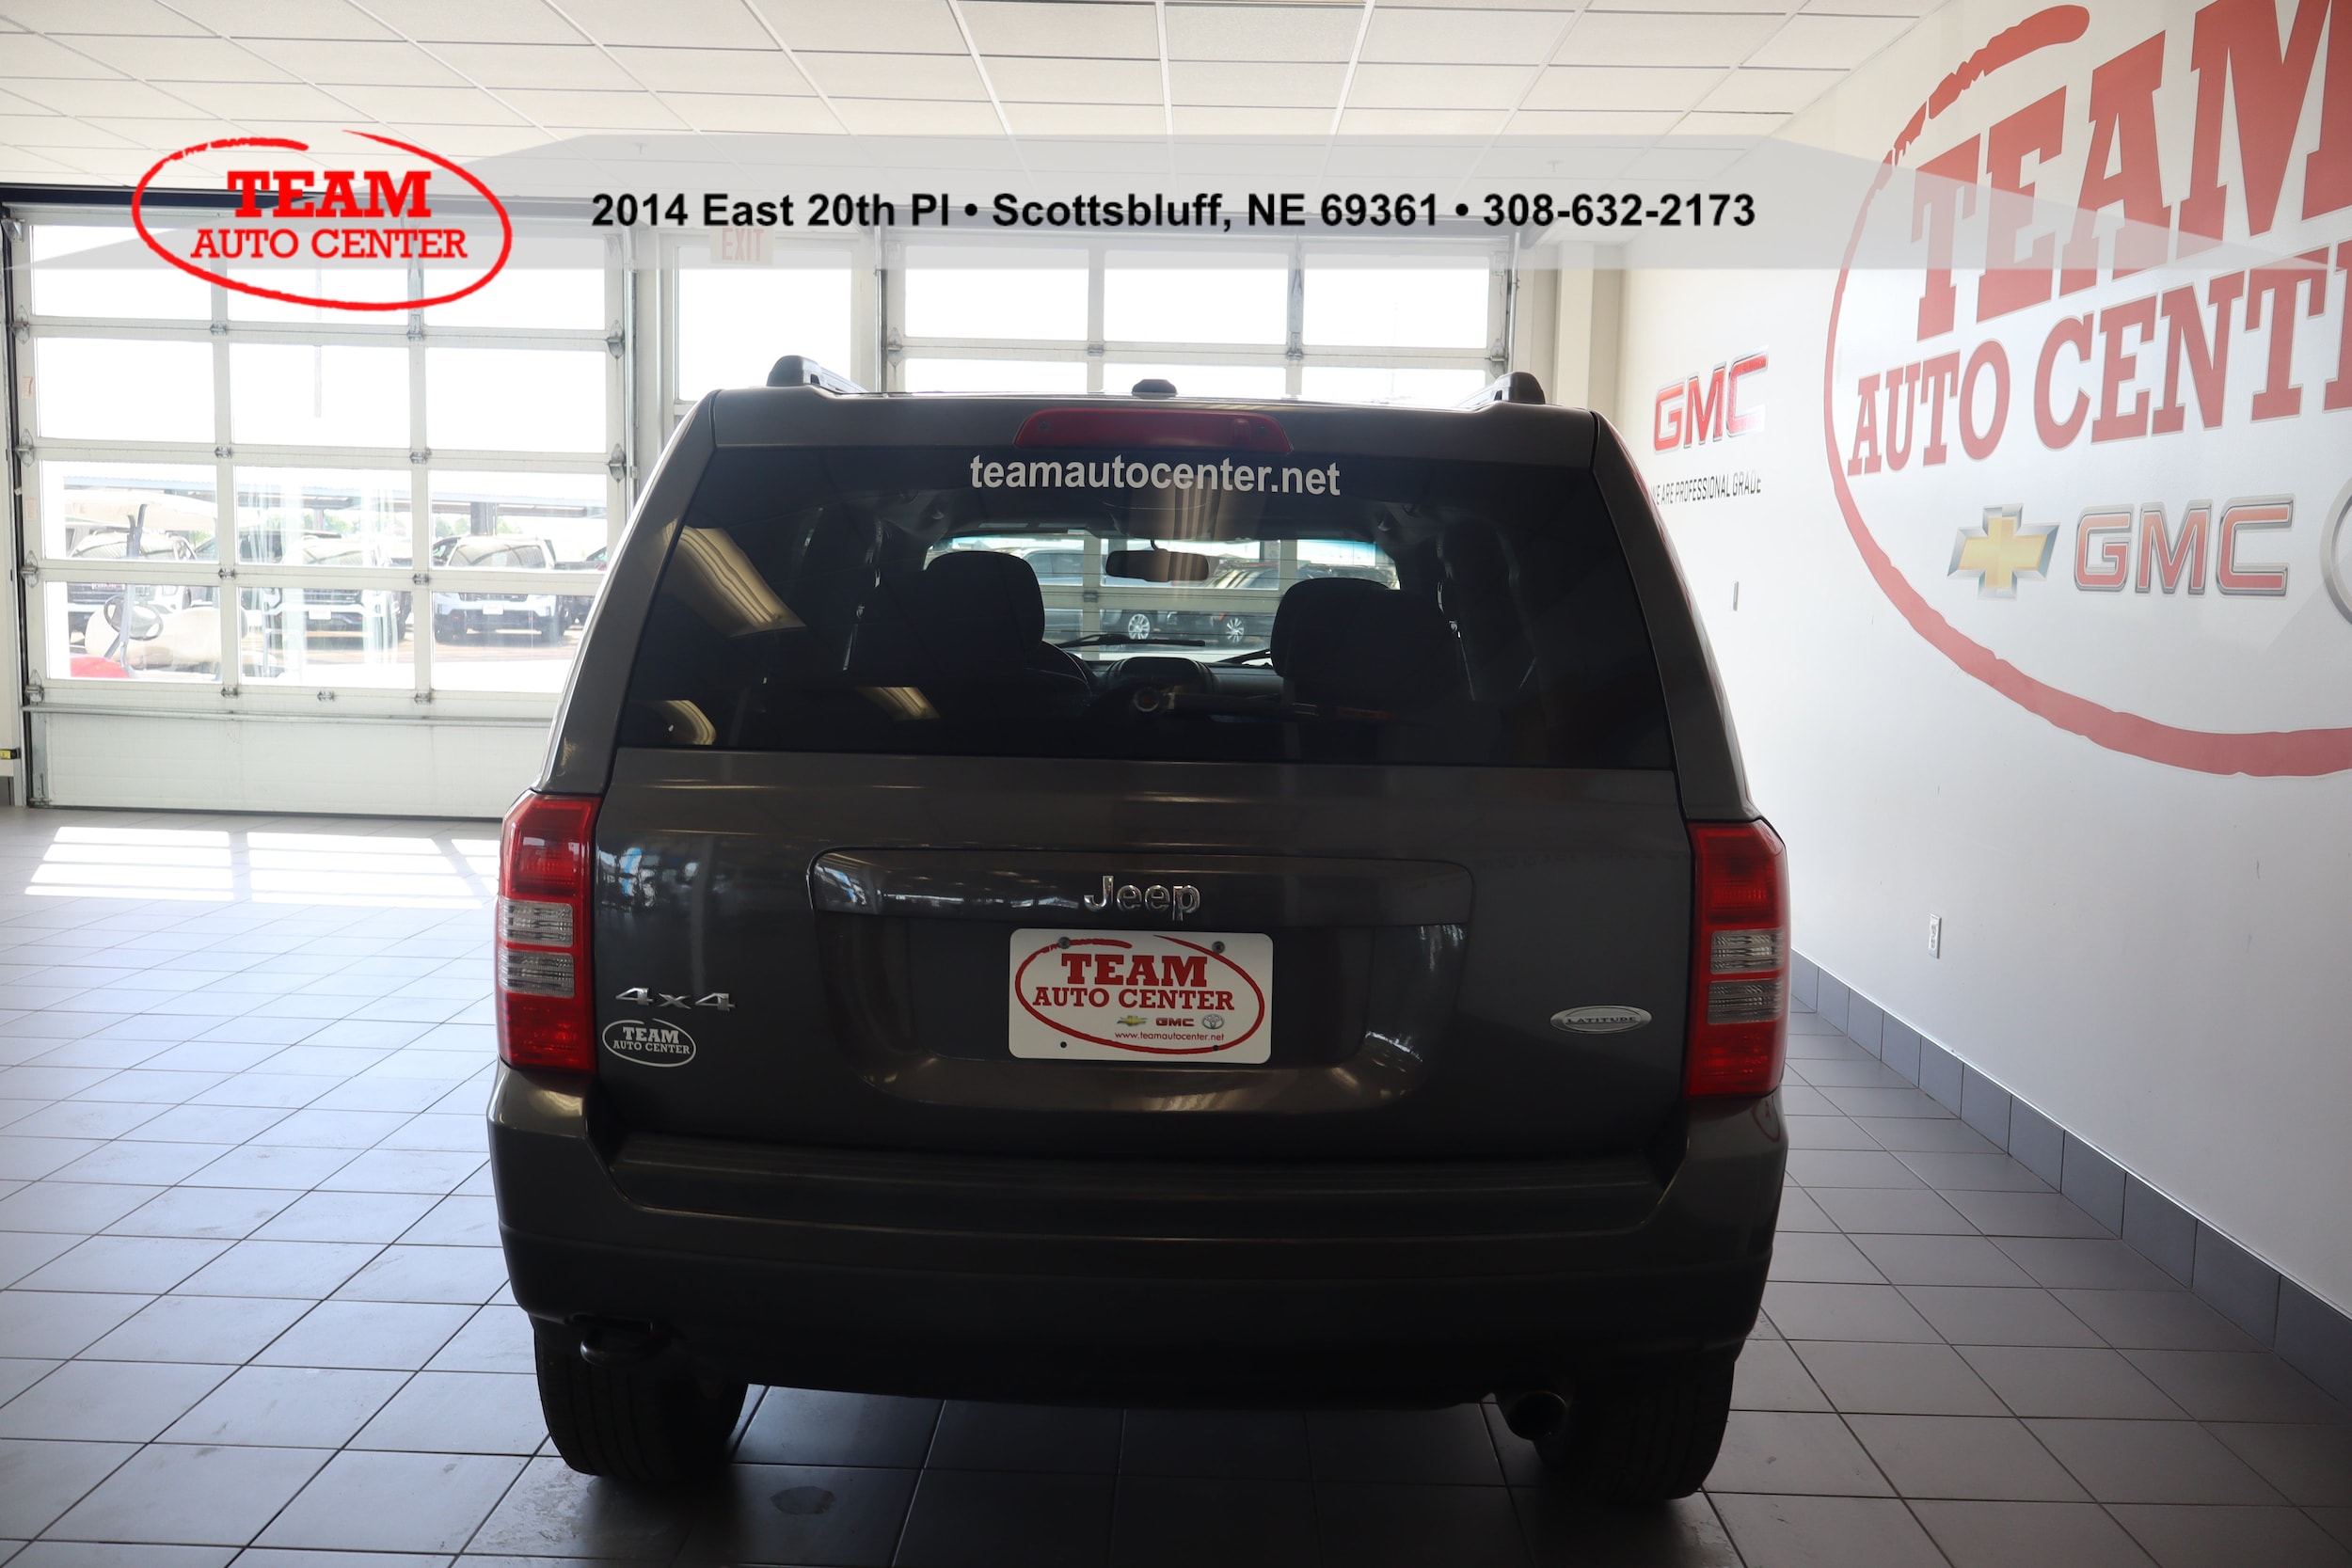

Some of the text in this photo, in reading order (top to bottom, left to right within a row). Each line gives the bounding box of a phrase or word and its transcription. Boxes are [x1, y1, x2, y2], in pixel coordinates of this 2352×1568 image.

[1910, 0, 2352, 342] TEAM
[722, 227, 765, 261] EXIT
[1654, 349, 1768, 454] GMC
[1847, 340, 2010, 478] AUTO
[970, 454, 1341, 496] teamautocenter.net
[1661, 483, 1675, 505] ARE
[1675, 474, 1730, 503] PROFESSIONAL
[1732, 469, 1761, 497] GRADE
[2074, 496, 2294, 597] GMC
[1084, 875, 1200, 922] Jeep
[1061, 953, 1208, 988] TEAM
[1032, 987, 1235, 1011] AUTO CENTER
[623, 1027, 679, 1043] TEAM
[1115, 1031, 1225, 1041] www.teamautocenter.net
[1155, 1017, 1195, 1027] GMC
[612, 1039, 691, 1054] AUTO CENTER
